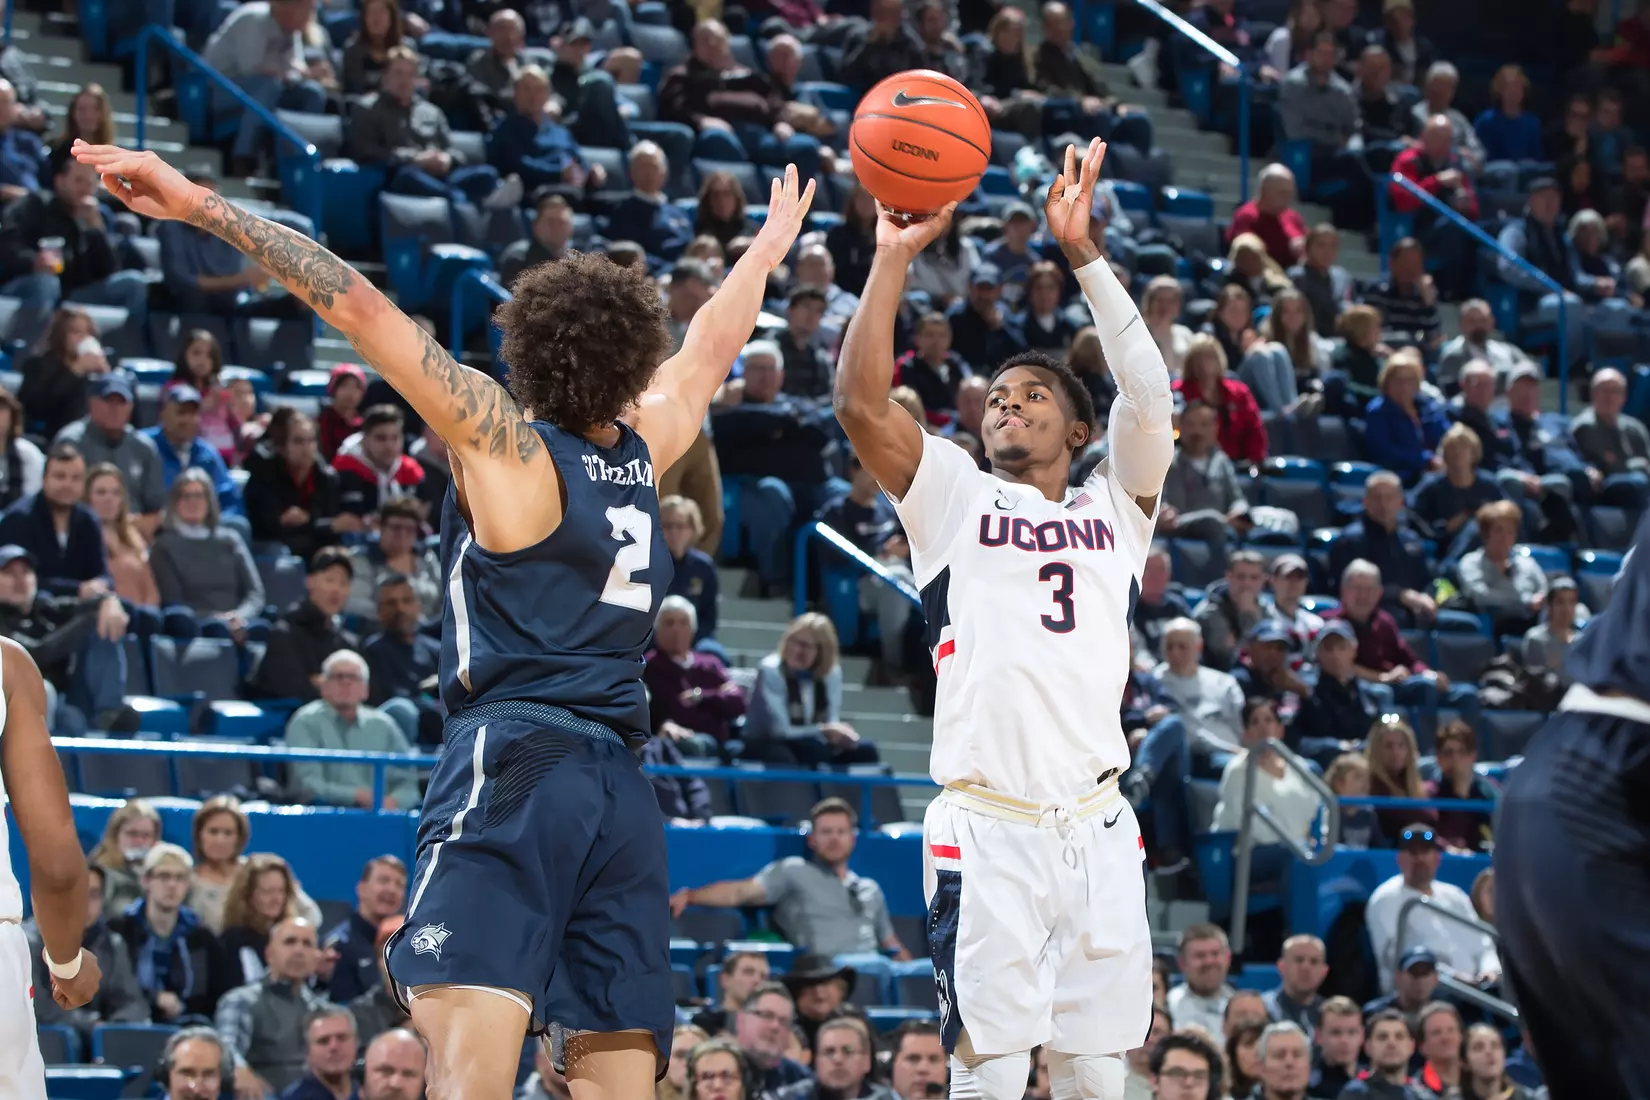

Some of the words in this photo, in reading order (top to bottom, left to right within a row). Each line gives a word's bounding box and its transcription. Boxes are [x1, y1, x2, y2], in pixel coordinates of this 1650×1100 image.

[892, 140, 940, 162] UCONN
[599, 504, 652, 613] 2
[979, 514, 1115, 552] UCONN
[1038, 561, 1076, 634] 3
